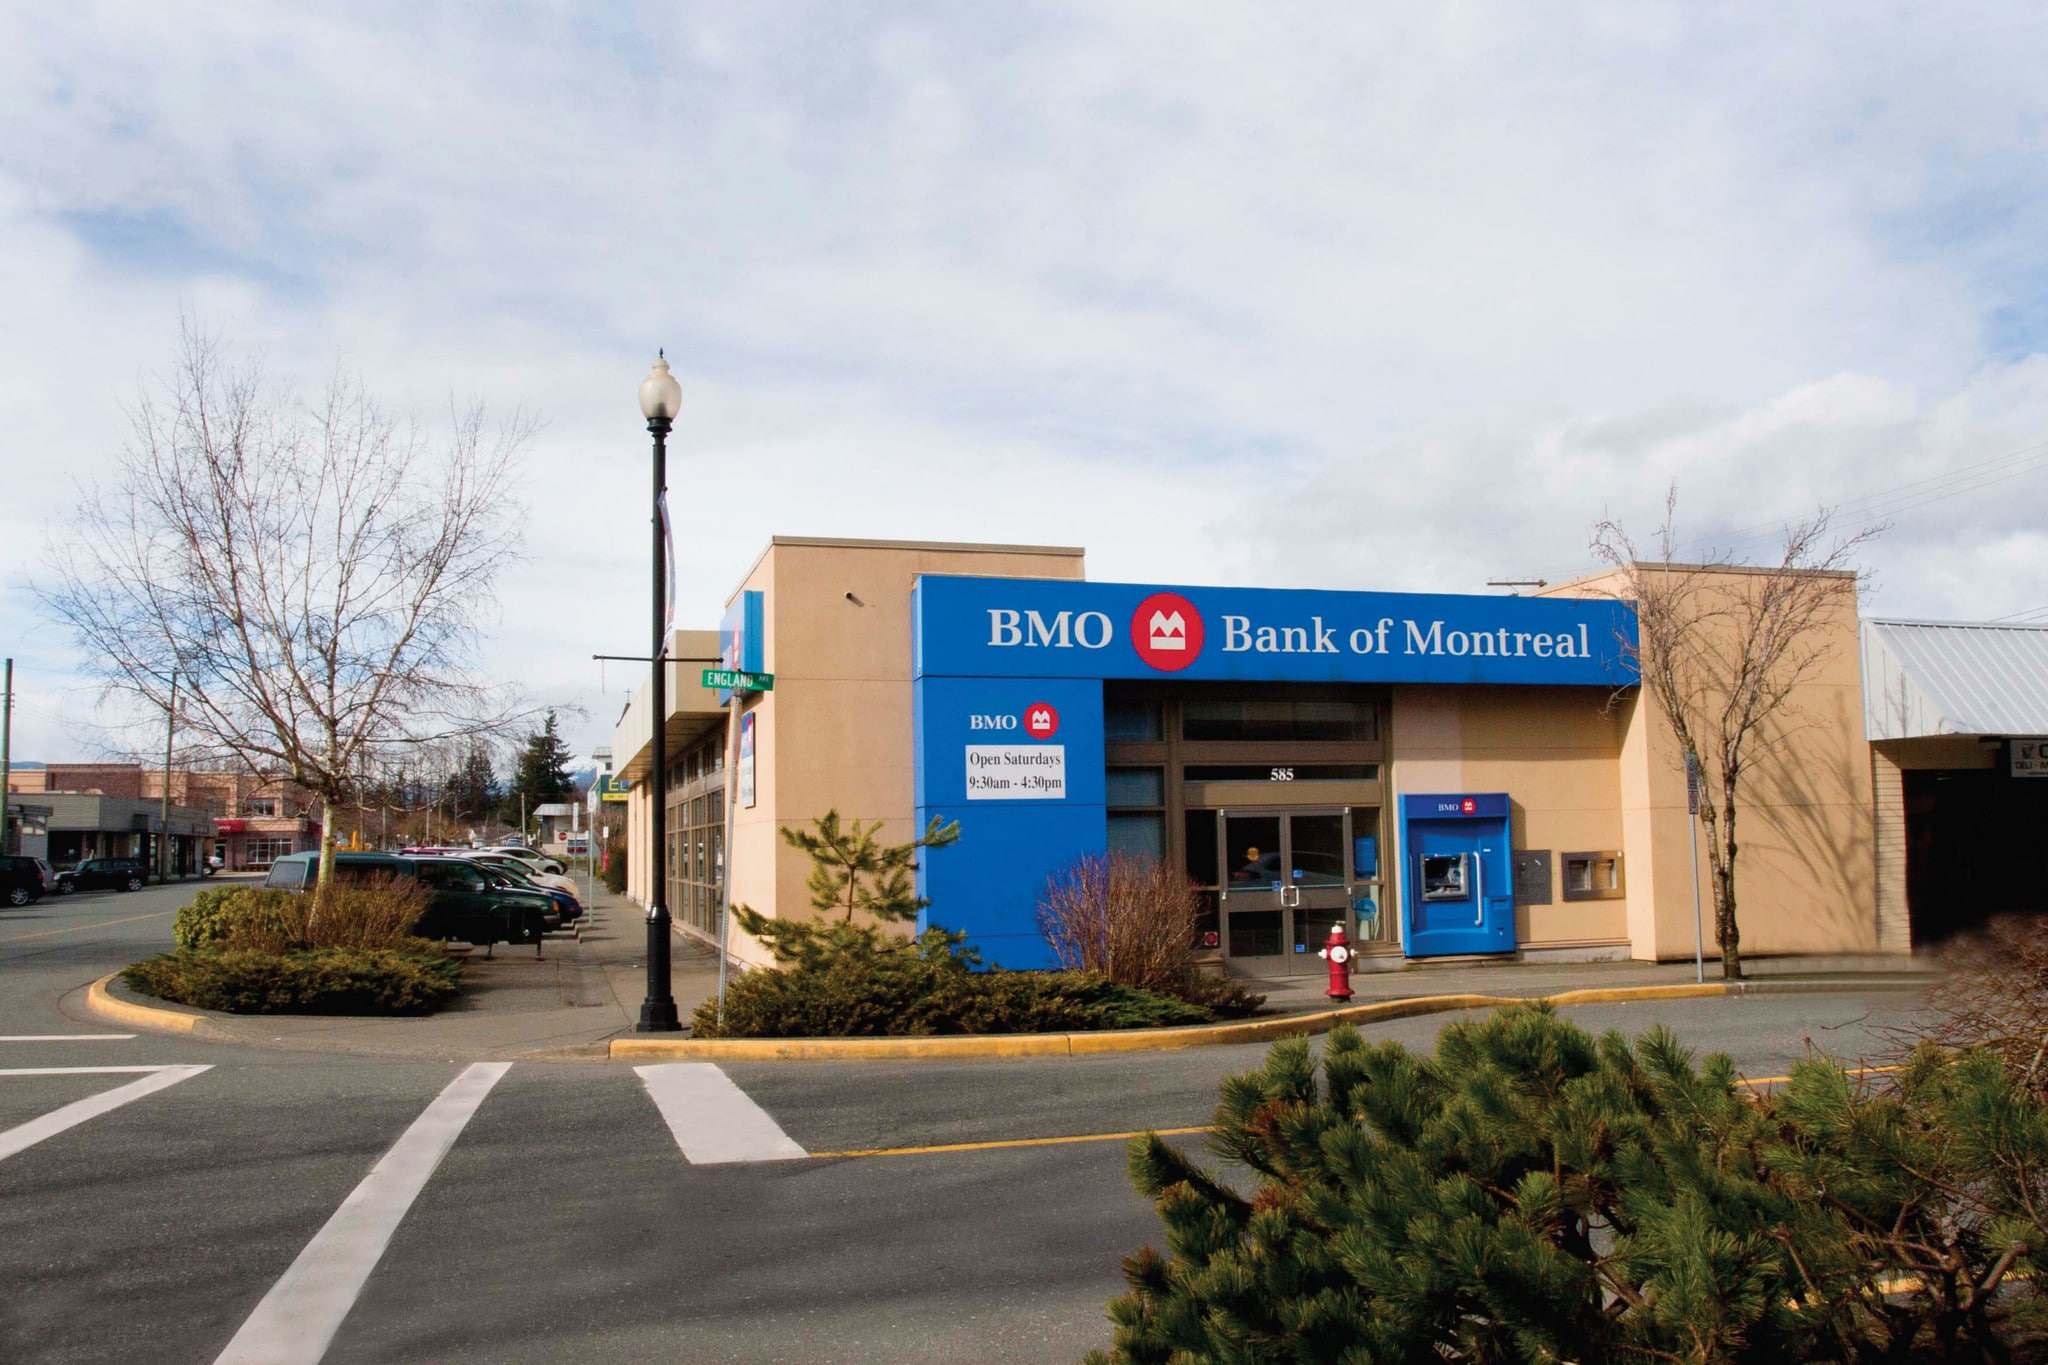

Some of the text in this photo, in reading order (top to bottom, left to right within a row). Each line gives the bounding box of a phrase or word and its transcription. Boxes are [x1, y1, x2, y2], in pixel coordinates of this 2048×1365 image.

[986, 609, 1114, 649] BMO
[1221, 615, 1592, 658] Bank of Montreal
[707, 672, 754, 688] ENGLAND
[969, 714, 1018, 730] BMO
[969, 751, 1061, 768] Open Saturdays
[1270, 767, 1295, 781] 585
[969, 775, 1011, 790] 9:30am
[1021, 775, 1063, 792] 4:30pm
[1438, 803, 1459, 812] BMO
